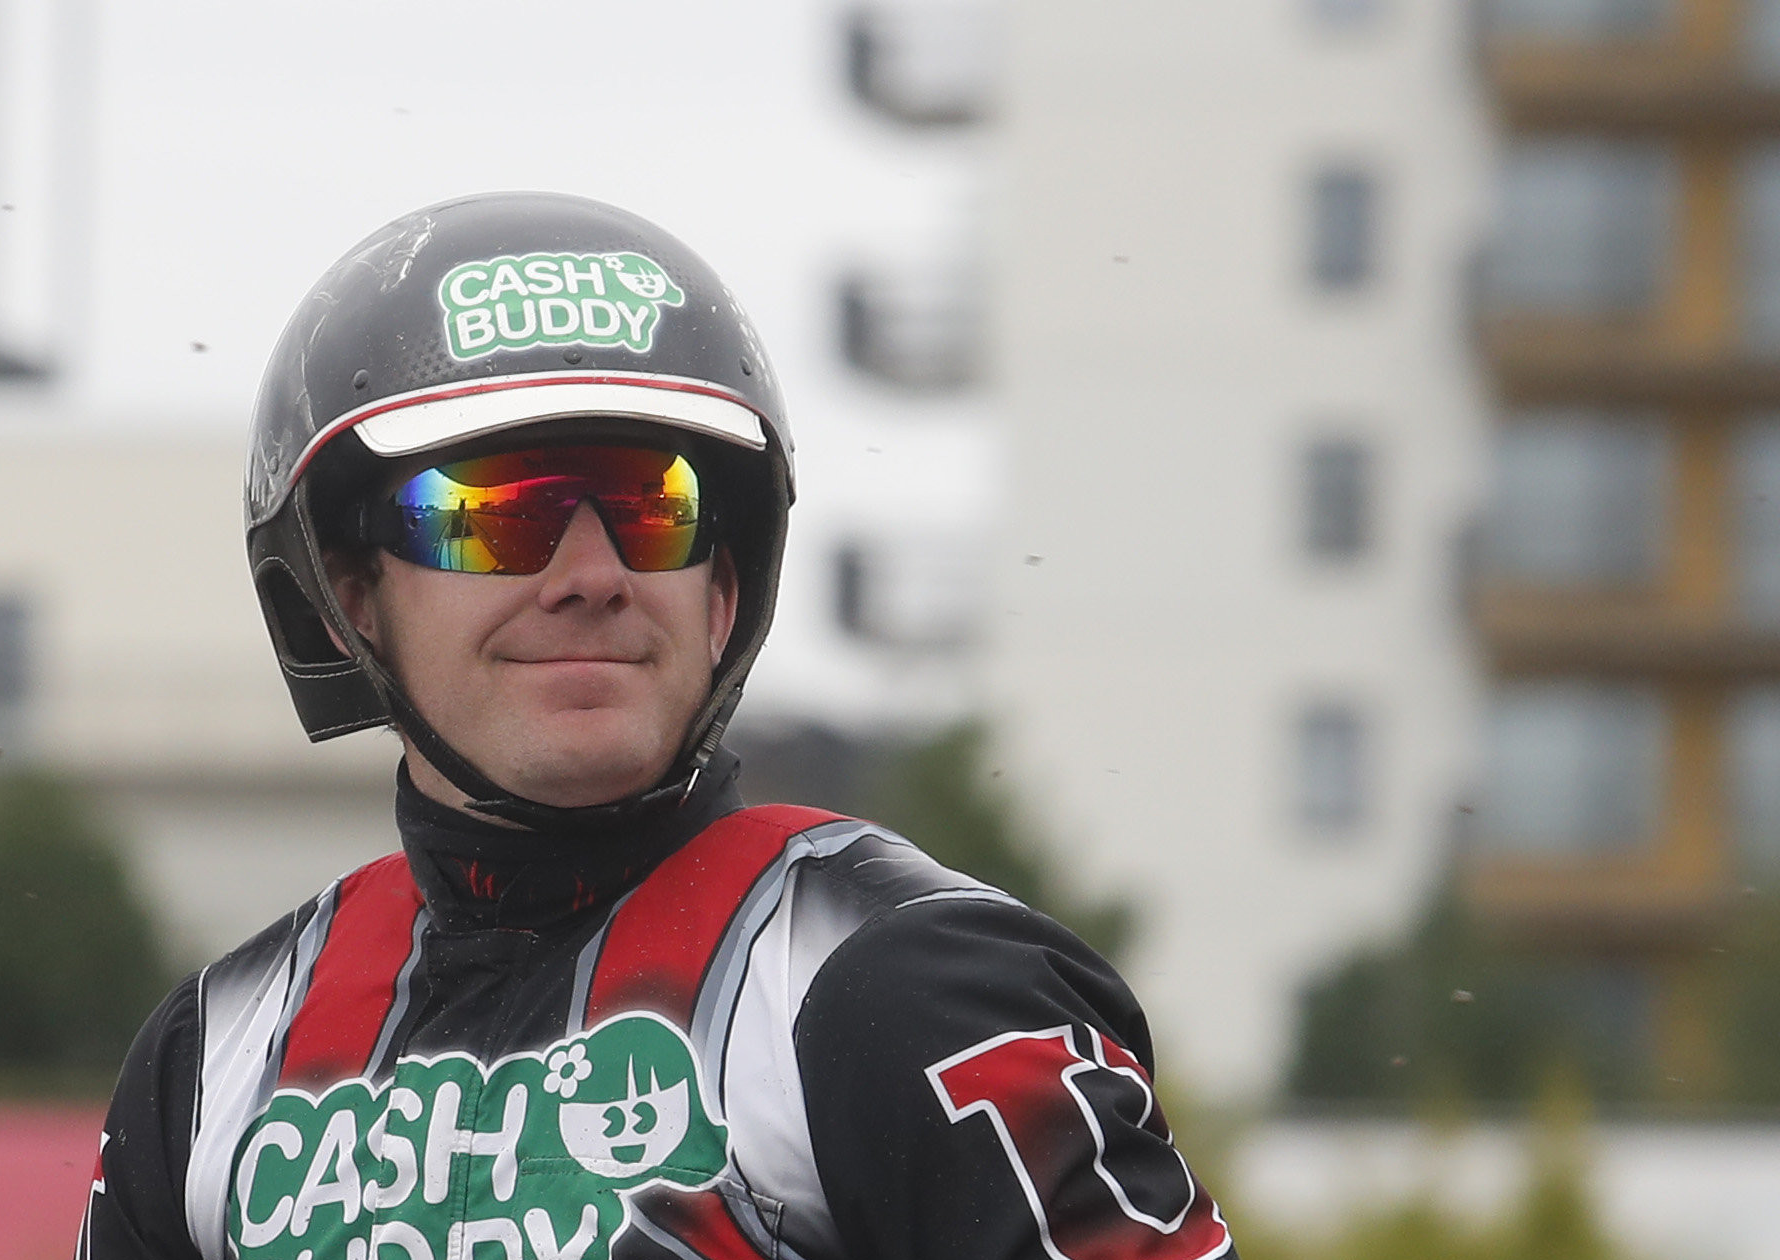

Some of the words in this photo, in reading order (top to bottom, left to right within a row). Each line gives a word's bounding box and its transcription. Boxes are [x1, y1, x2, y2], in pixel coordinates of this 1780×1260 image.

[449, 260, 606, 307] CASH
[455, 298, 649, 350] BUDDY
[236, 1081, 528, 1248] CASH
